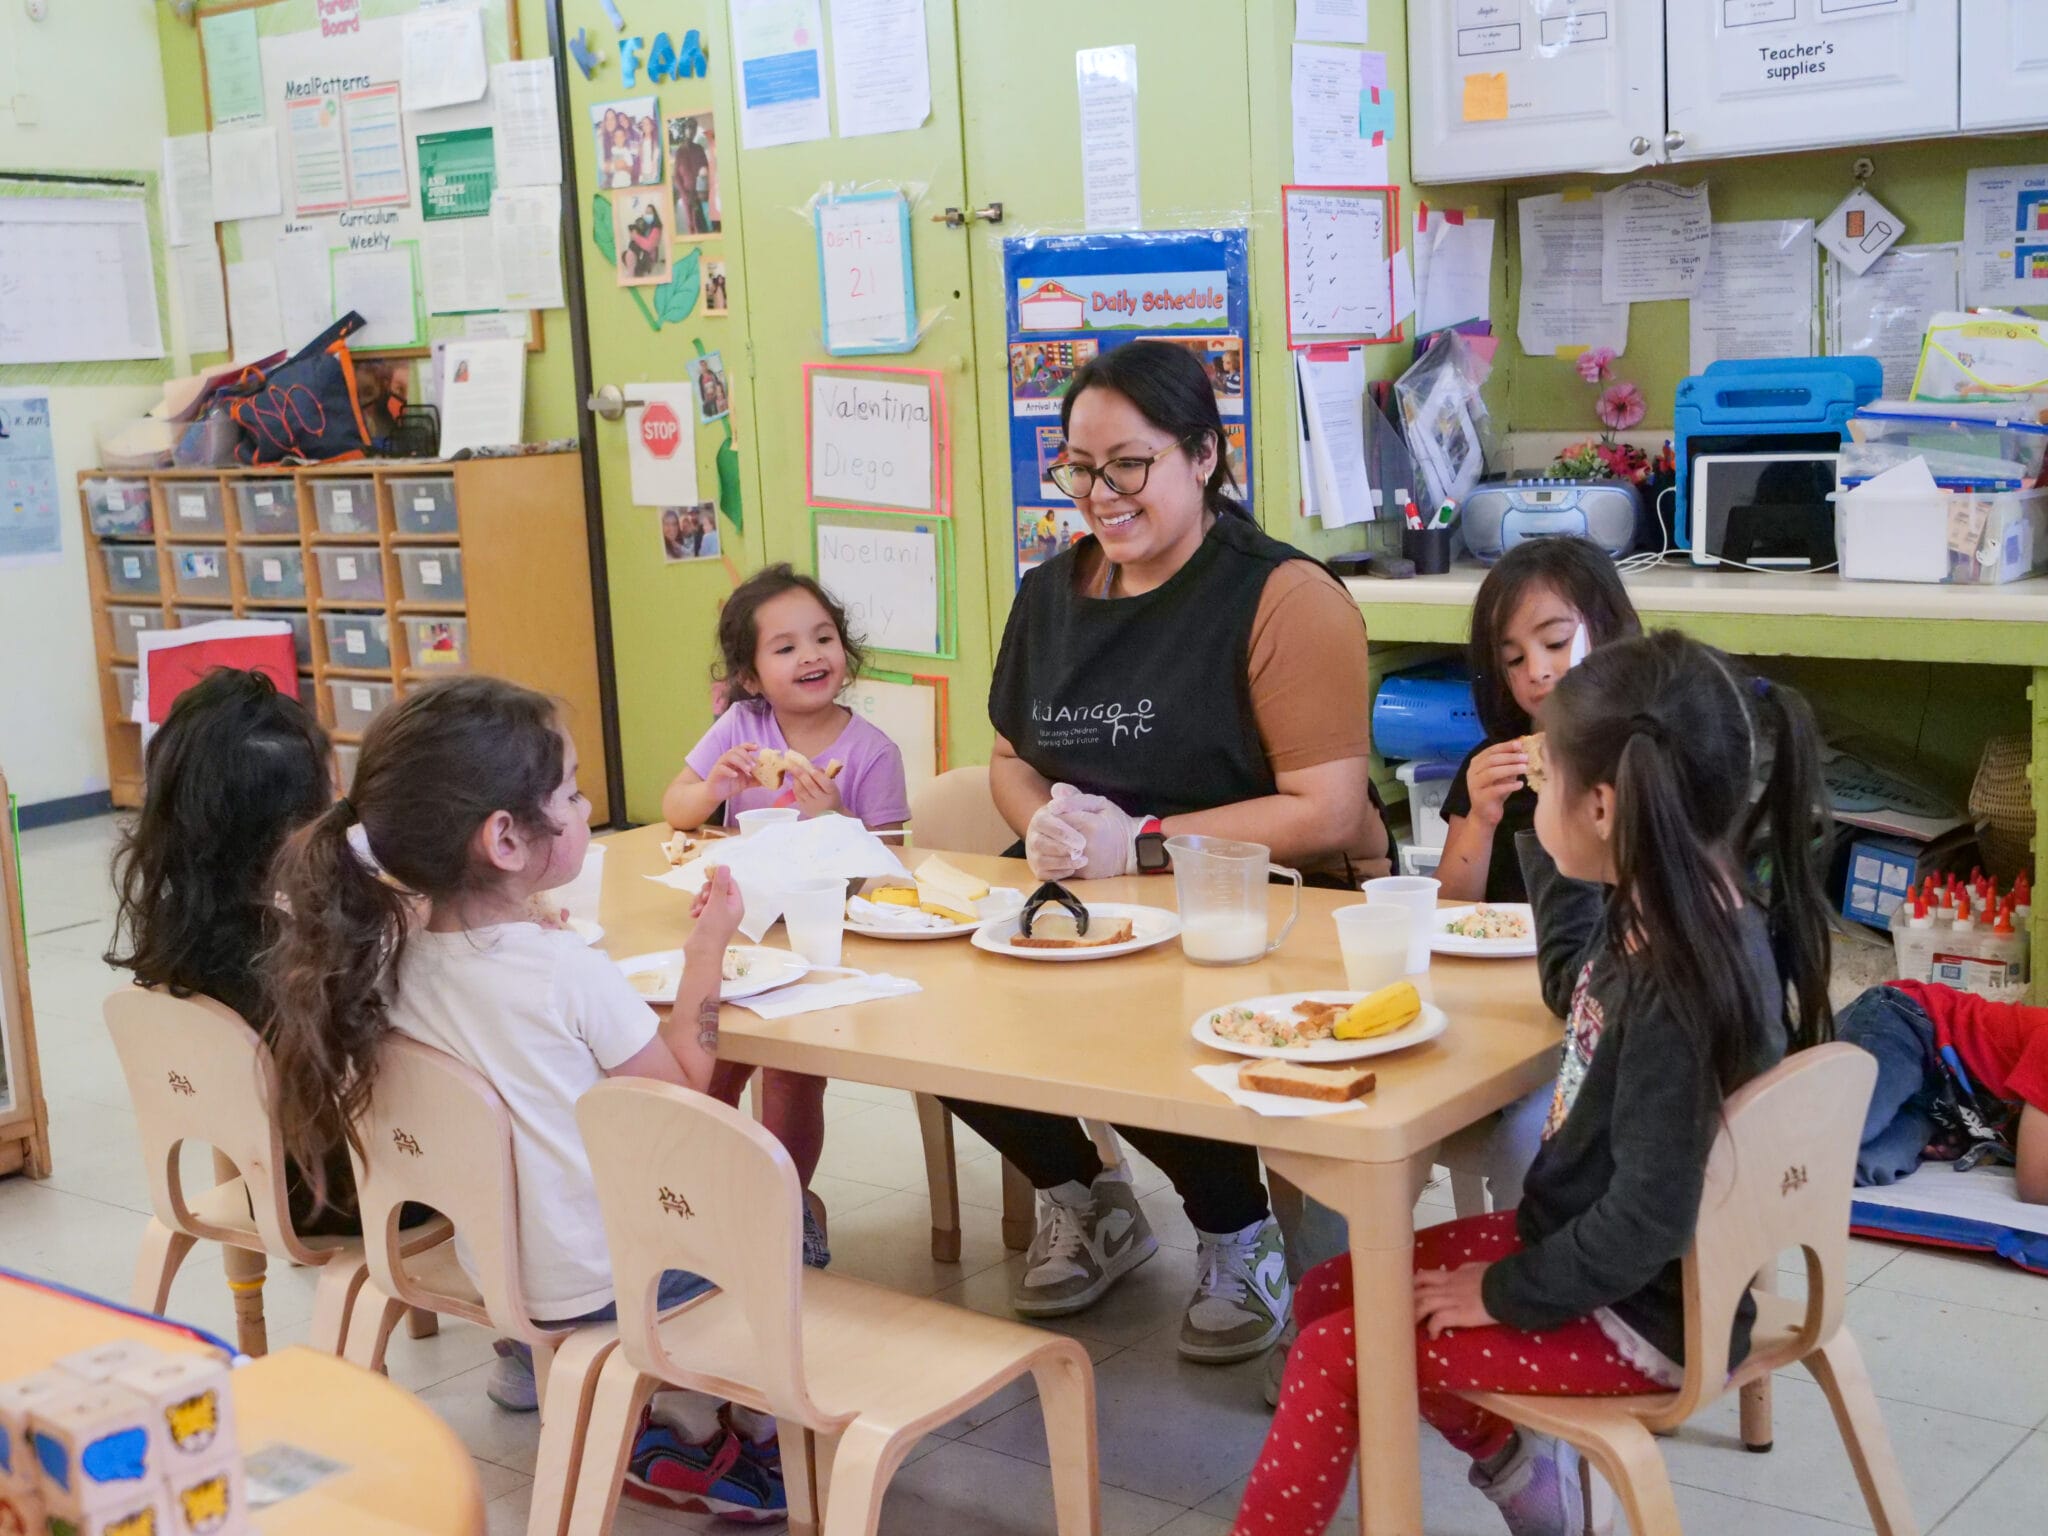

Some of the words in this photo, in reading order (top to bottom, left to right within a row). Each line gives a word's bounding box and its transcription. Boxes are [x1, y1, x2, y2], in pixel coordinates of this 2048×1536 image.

[322, 16, 361, 37] Board
[1758, 41, 1834, 61] Teacher's
[1767, 61, 1826, 81] supplies
[340, 210, 399, 227] Curriculum
[349, 231, 391, 252] Weekly
[1091, 291, 1136, 317] Daily
[1143, 287, 1224, 311] Schedule
[818, 385, 929, 432] Valentina
[644, 422, 677, 440] STOP
[823, 443, 895, 491] Diego
[822, 534, 919, 565] Noelani
[1062, 738, 1074, 746] Our
[1076, 736, 1100, 745] Future
[1070, 727, 1098, 736] Children
